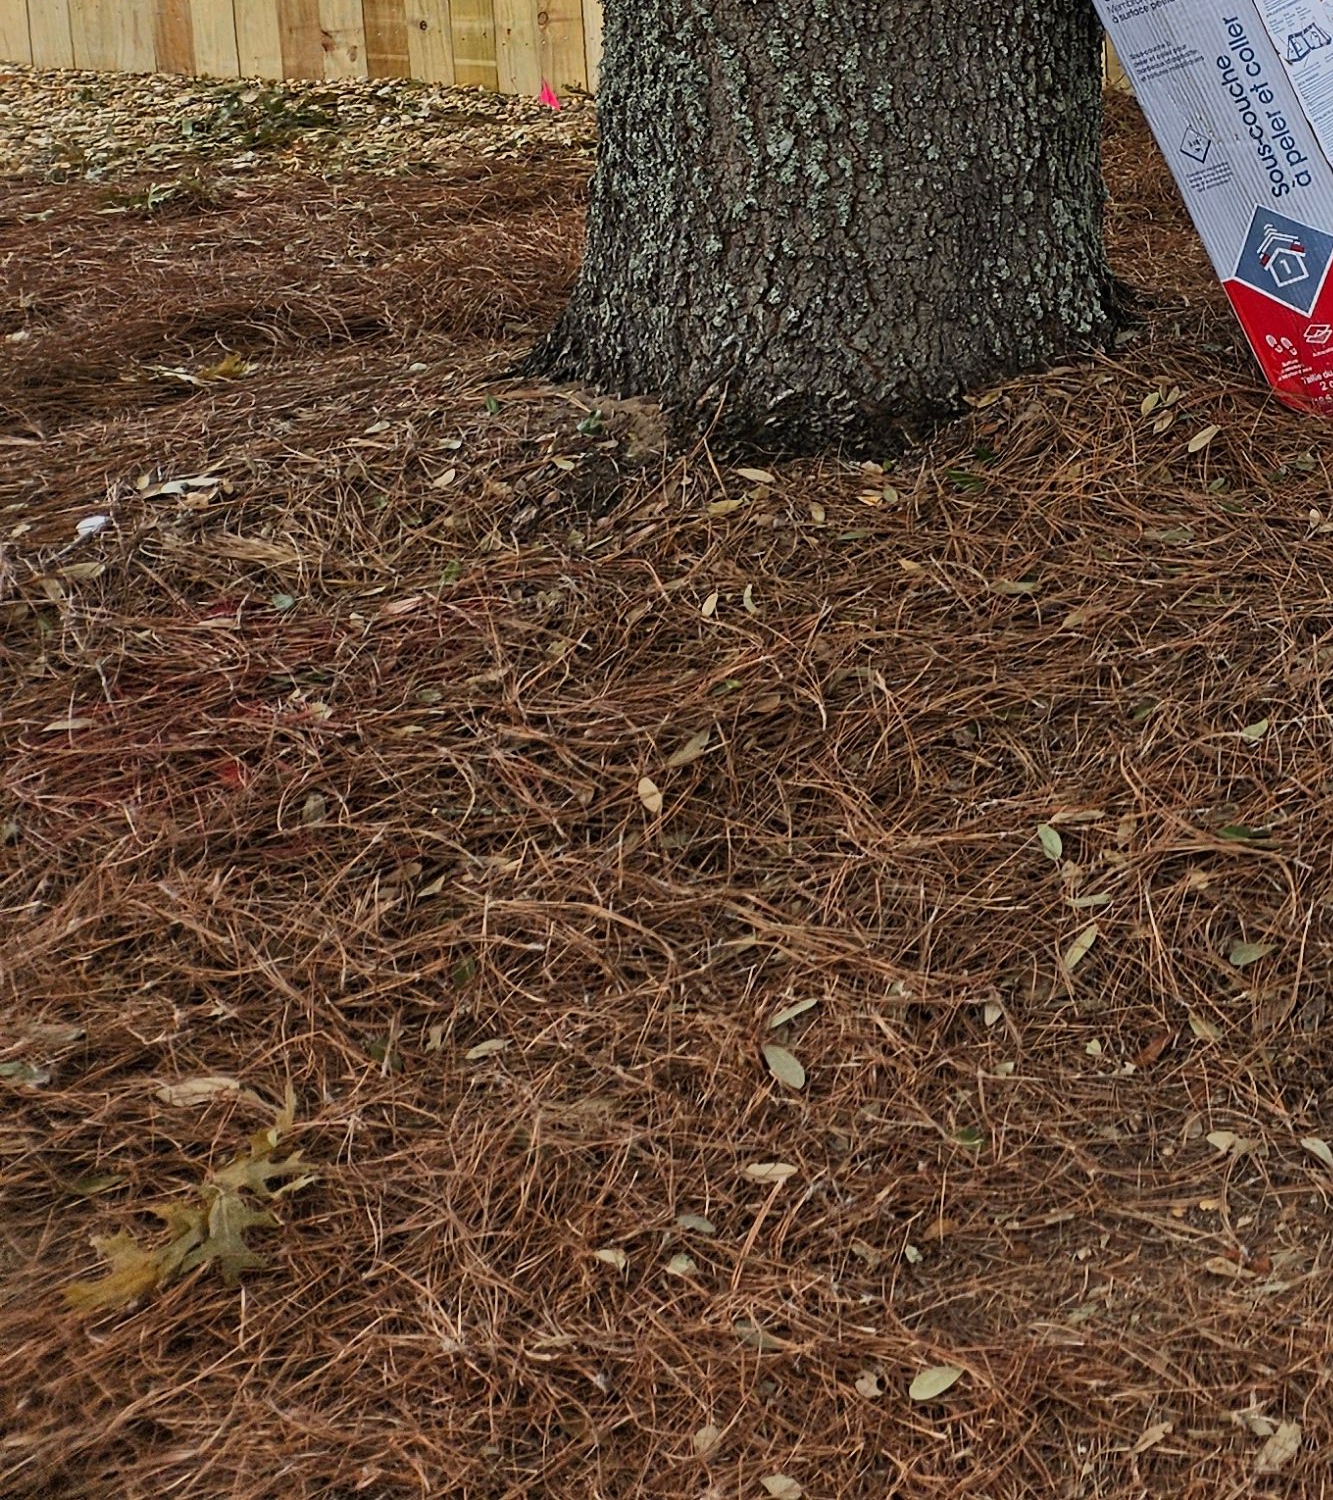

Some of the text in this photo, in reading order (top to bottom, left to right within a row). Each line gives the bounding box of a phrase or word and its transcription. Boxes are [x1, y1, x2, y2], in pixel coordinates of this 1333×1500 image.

[1119, 4, 1150, 22] surface
[1222, 16, 1312, 188] à peler et coller
[1216, 54, 1290, 198] Sous-couche
[1279, 258, 1292, 275] 1
[1323, 368, 1333, 379] du
[1319, 381, 1329, 391] 2
